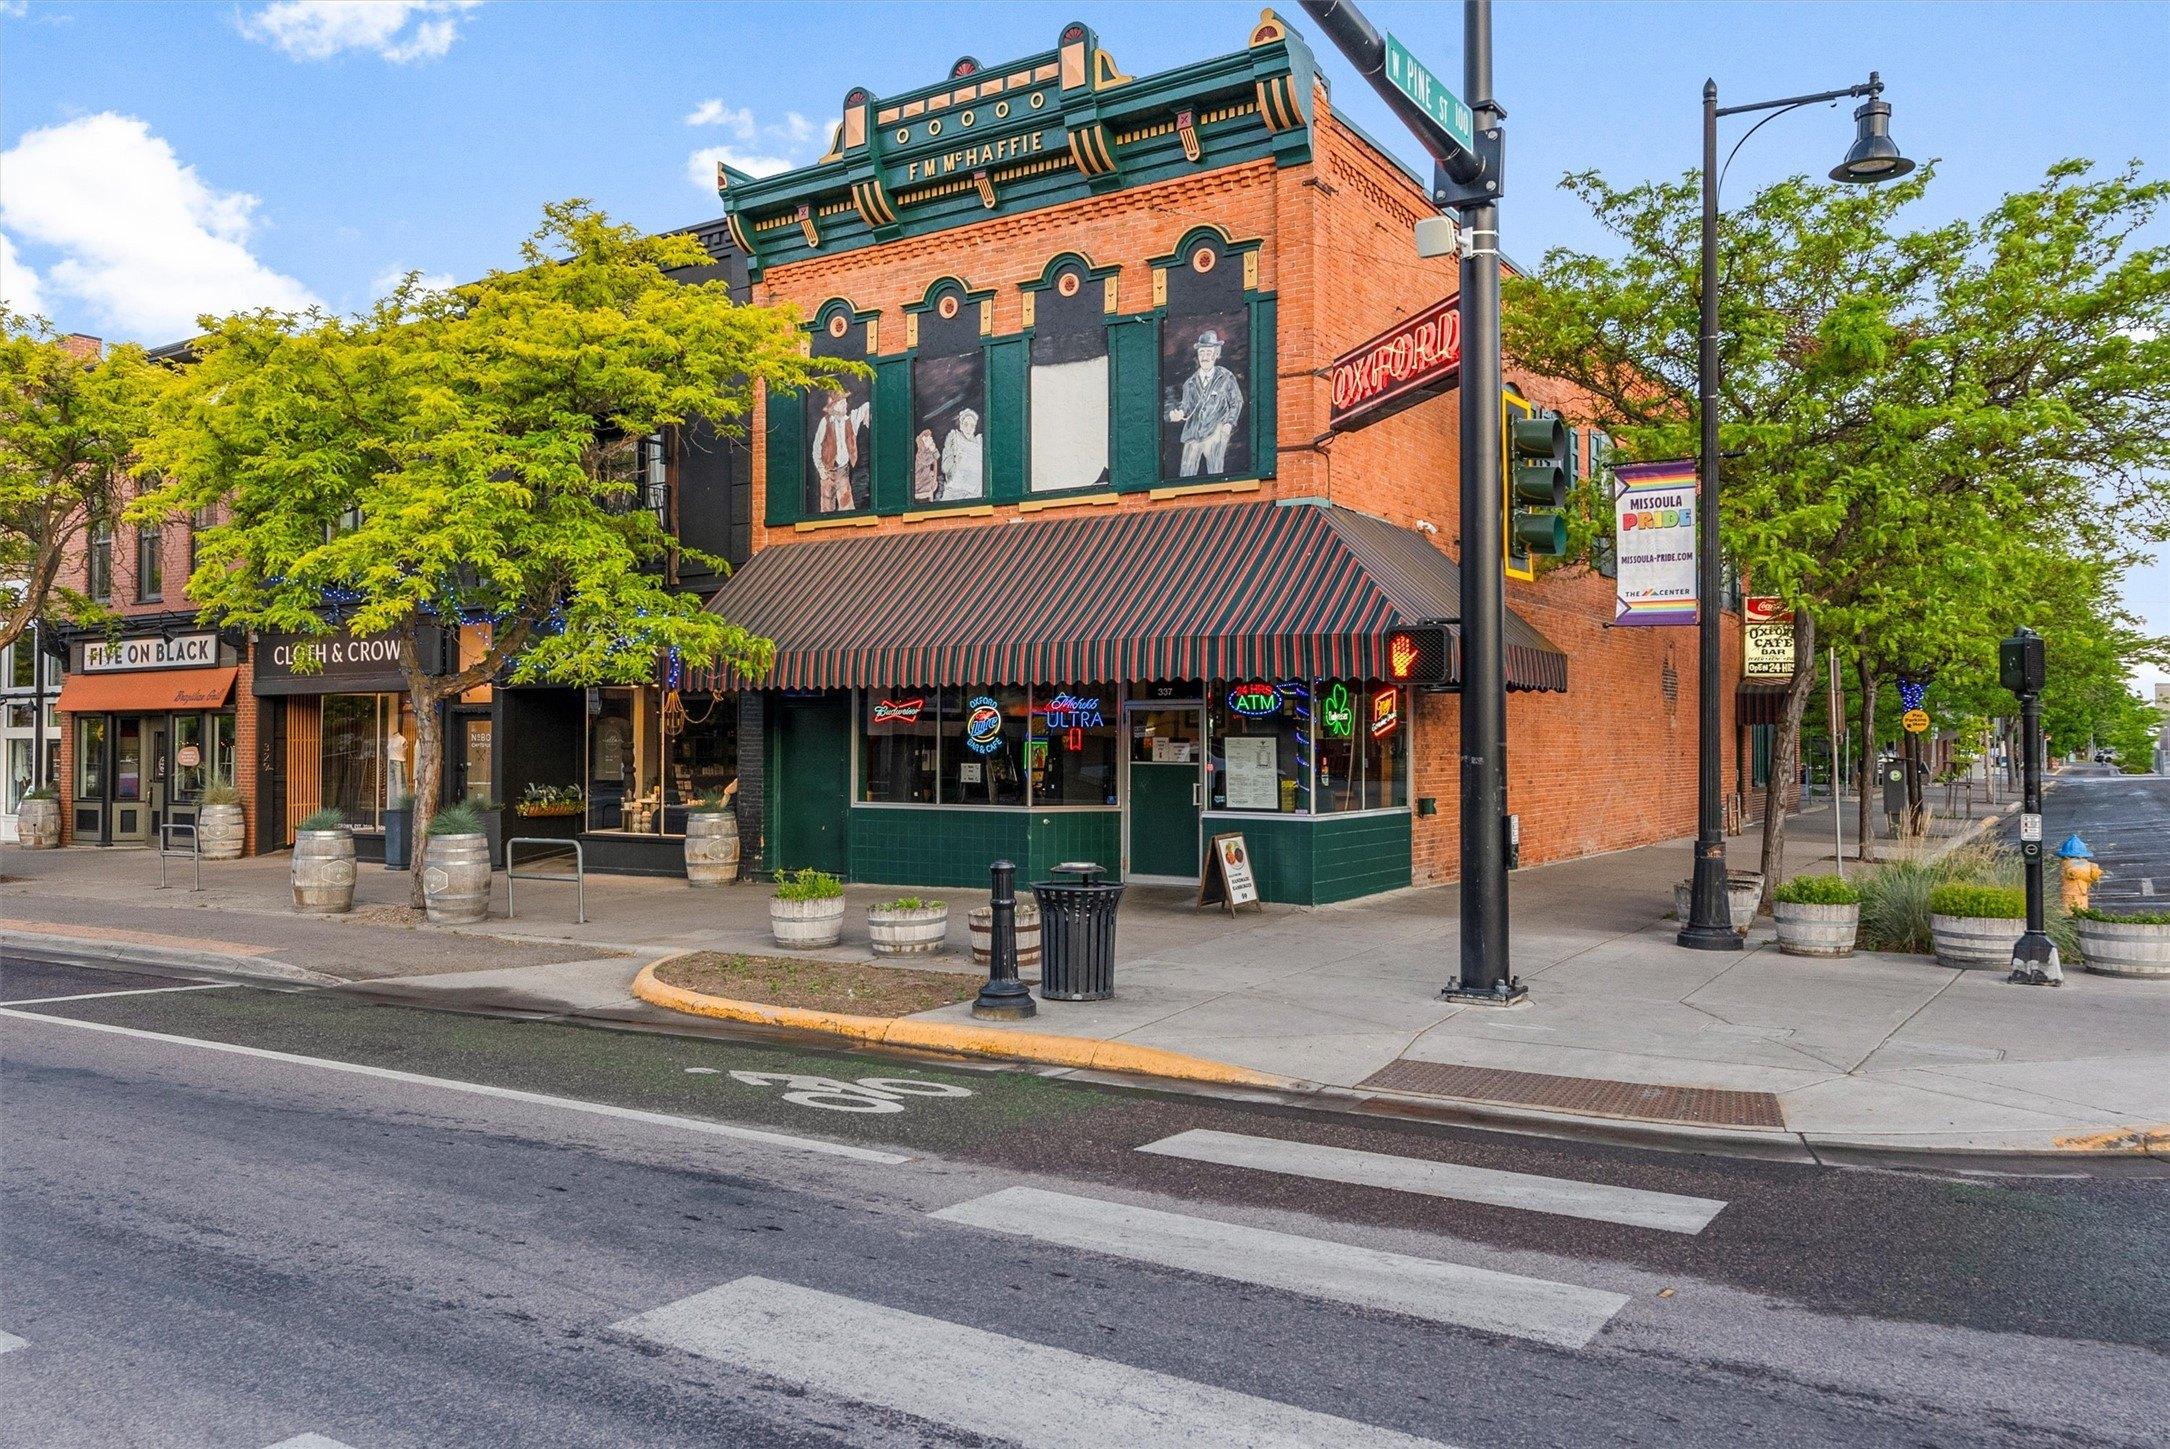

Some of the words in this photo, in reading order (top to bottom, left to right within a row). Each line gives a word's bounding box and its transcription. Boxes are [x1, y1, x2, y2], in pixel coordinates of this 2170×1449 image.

[1391, 49, 1400, 79] W
[1406, 58, 1432, 110] PINE
[1439, 95, 1449, 124] ST
[1454, 103, 1469, 136] 100
[909, 163, 918, 181] F
[924, 158, 937, 178] M
[1331, 308, 1460, 410] OXFORD
[1630, 495, 1682, 510] MISSOULA
[1622, 508, 1692, 531] PRIDE
[1621, 552, 1693, 564] MISSOULA-PRIDE.COM
[1659, 588, 1690, 596] CENTER
[1749, 625, 1795, 639] OXFOR
[1754, 638, 1793, 648] CAFE
[128, 643, 150, 664] ON
[156, 639, 209, 662] BLACK
[274, 643, 326, 665] CLOTH
[332, 642, 343, 662] &
[347, 640, 400, 662] CROW
[1769, 663, 1781, 673] 24
[1158, 688, 1173, 696] 337
[1235, 685, 1249, 695] 24
[1250, 684, 1273, 695] HRS
[969, 696, 998, 709] OXFORD
[1236, 694, 1275, 710] ATM
[874, 705, 921, 717] Budweiser
[1046, 711, 1104, 727] ULTRA
[966, 738, 980, 752] BAR
[985, 737, 1003, 753] CAFE
